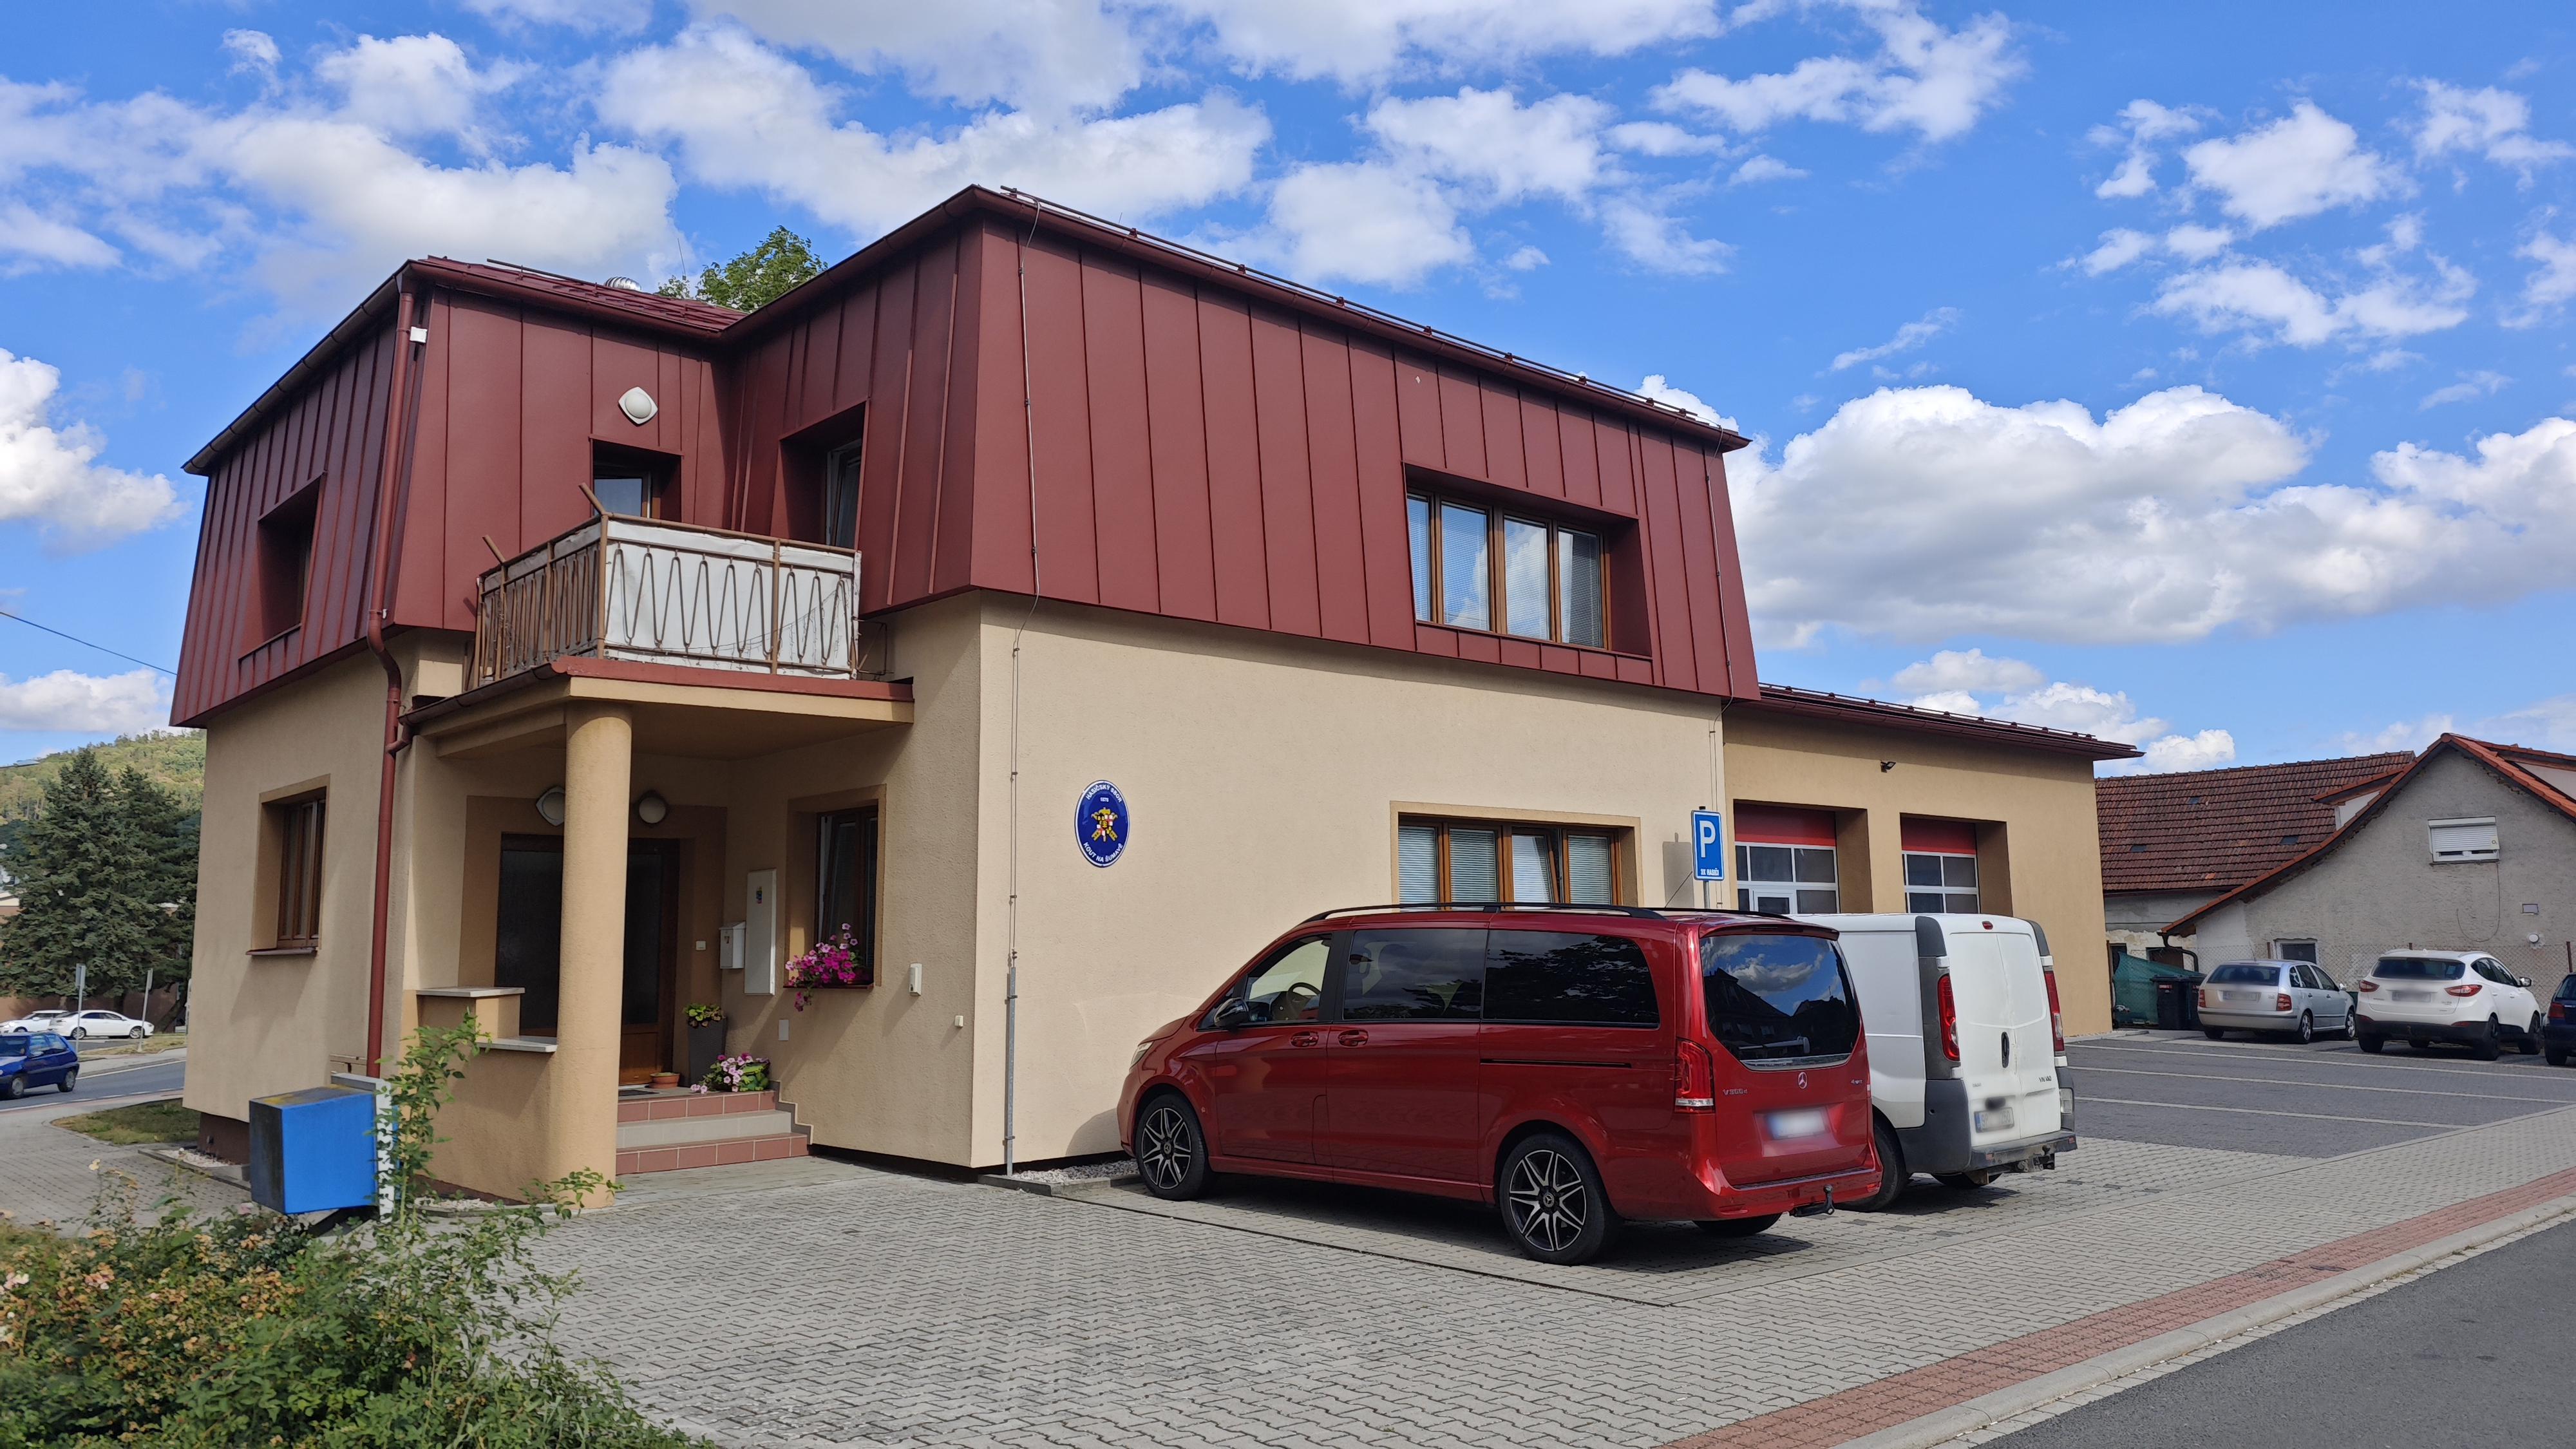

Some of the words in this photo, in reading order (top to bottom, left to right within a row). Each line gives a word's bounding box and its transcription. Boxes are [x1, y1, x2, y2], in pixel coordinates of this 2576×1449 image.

[1110, 788, 1122, 803] SBOR
[1700, 820, 1716, 858] P
[1083, 842, 1097, 858] KOUT
